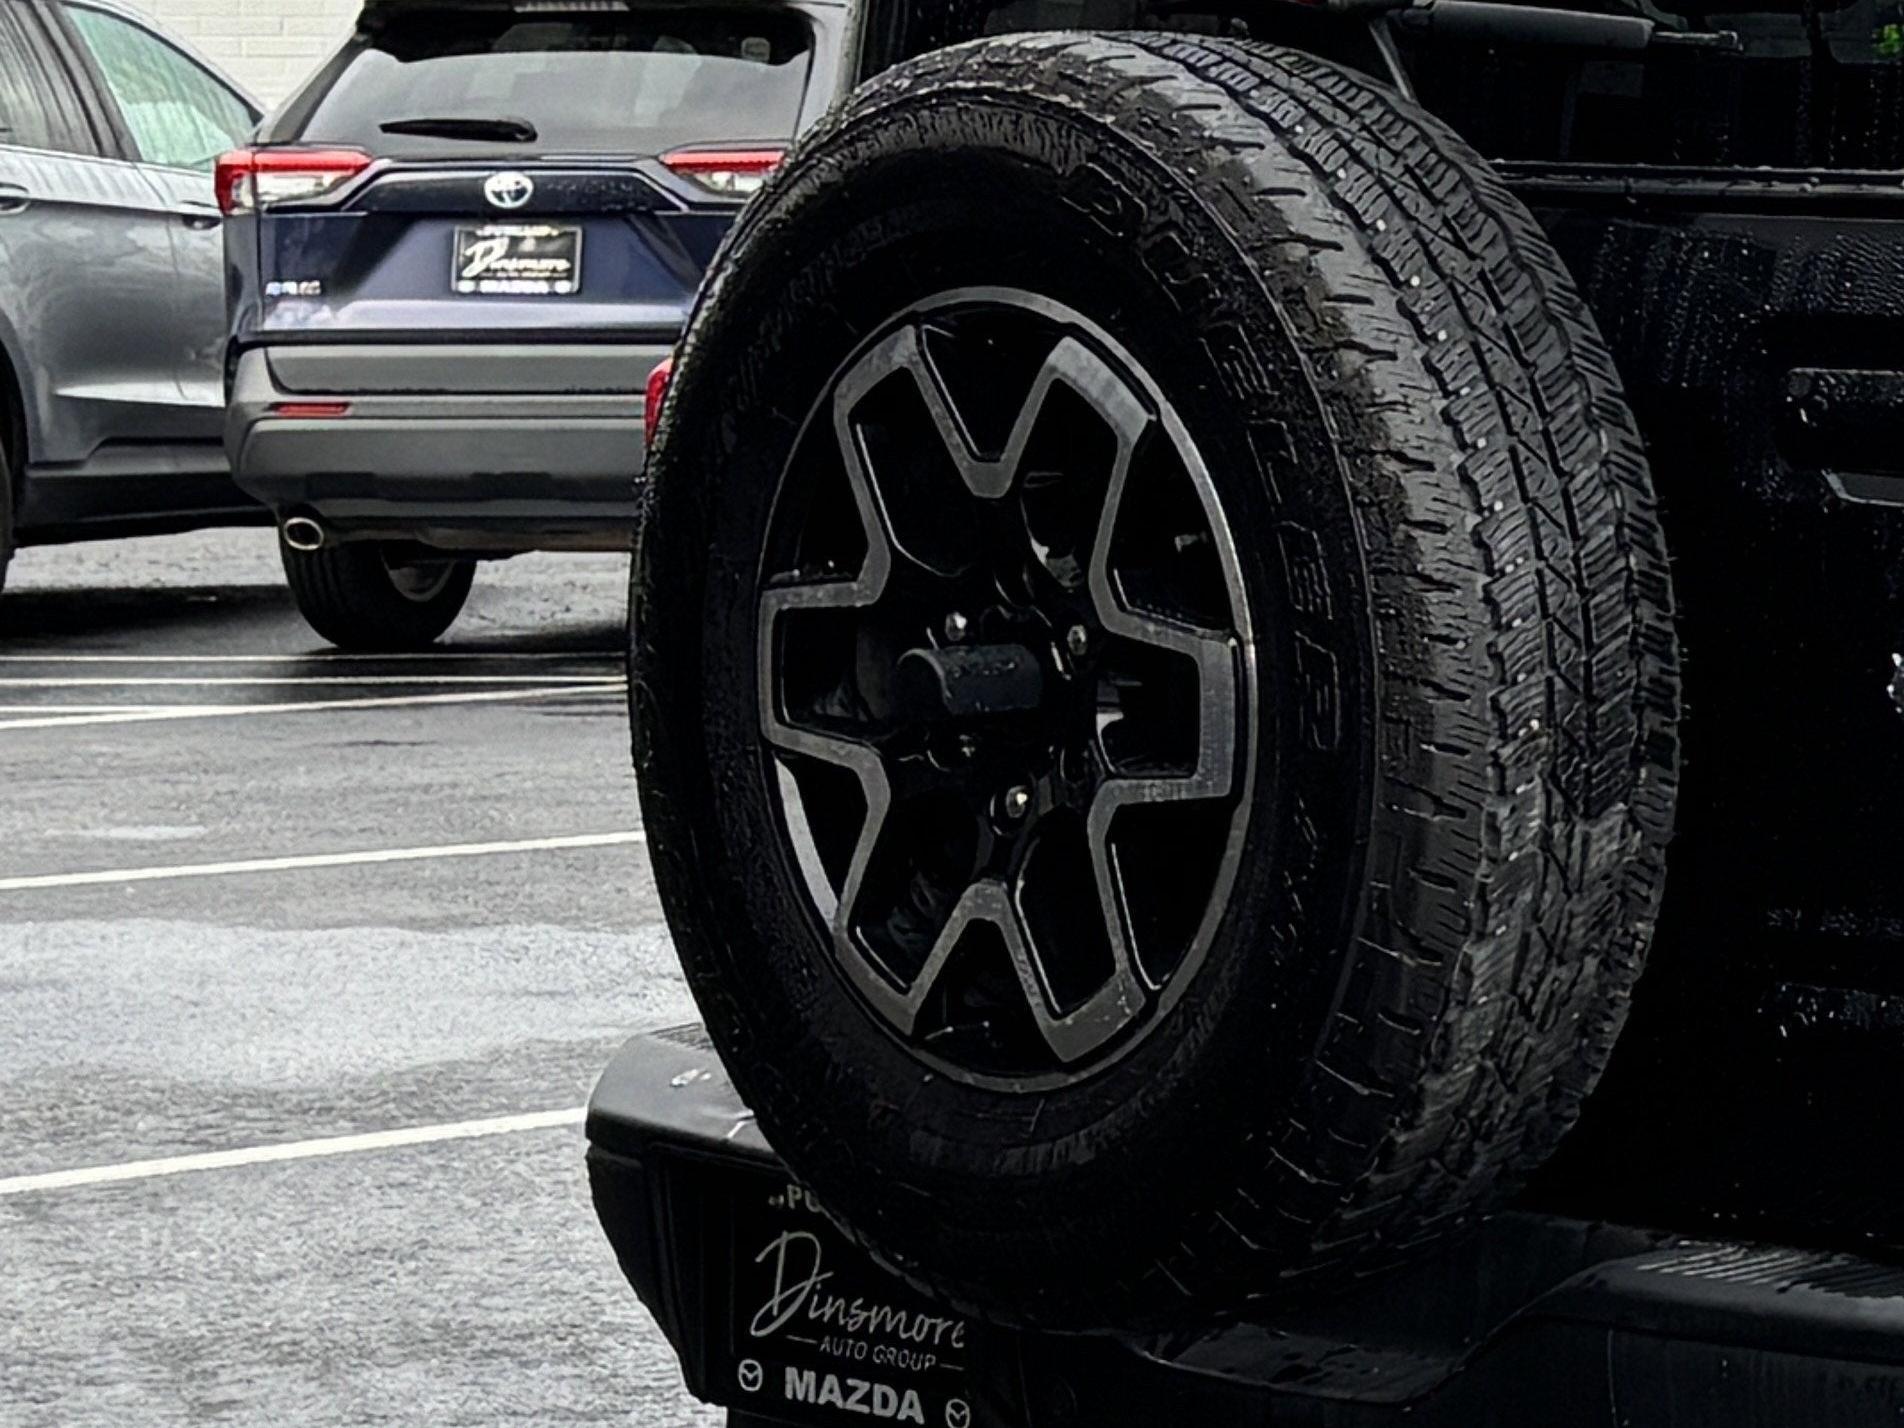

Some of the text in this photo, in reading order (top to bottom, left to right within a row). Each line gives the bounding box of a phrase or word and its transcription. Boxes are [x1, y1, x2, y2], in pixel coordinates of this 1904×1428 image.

[749, 1229, 966, 1349] Dinsmore
[820, 1336, 937, 1372] AUTO GROUP
[784, 1365, 926, 1426] MAZDA
